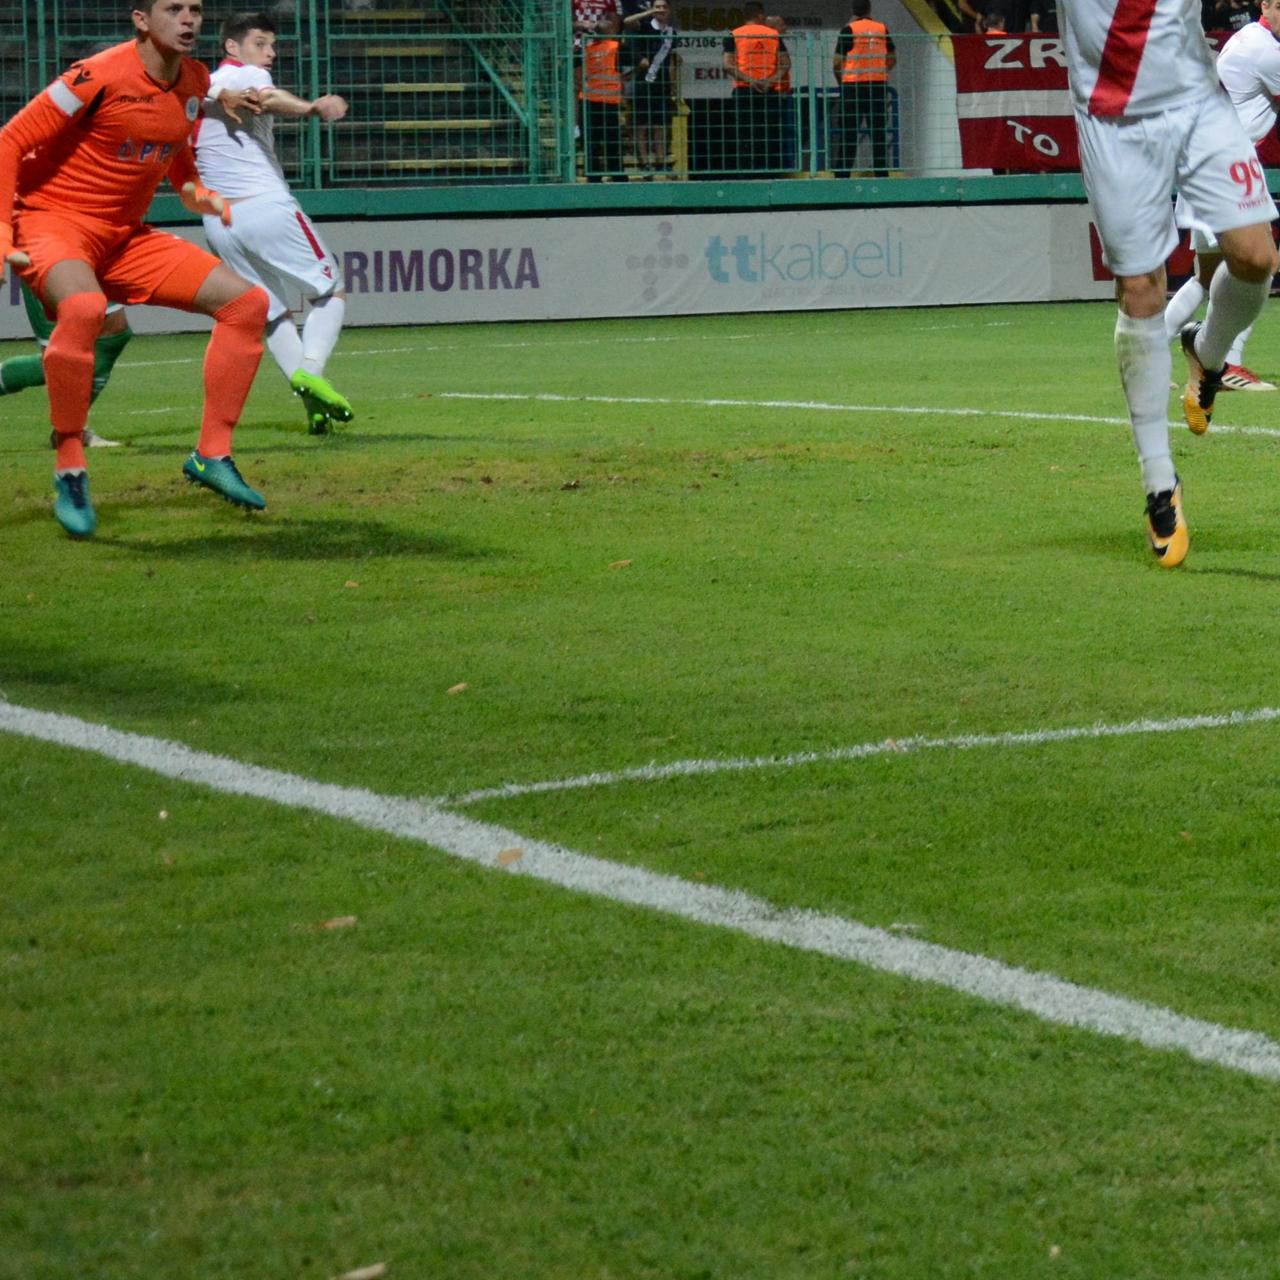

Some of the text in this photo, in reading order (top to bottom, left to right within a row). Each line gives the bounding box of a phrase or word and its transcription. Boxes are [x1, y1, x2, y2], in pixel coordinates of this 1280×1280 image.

[1229, 156, 1265, 197] 99
[333, 246, 541, 294] RIMORKA
[704, 227, 905, 283] ttkabeli
